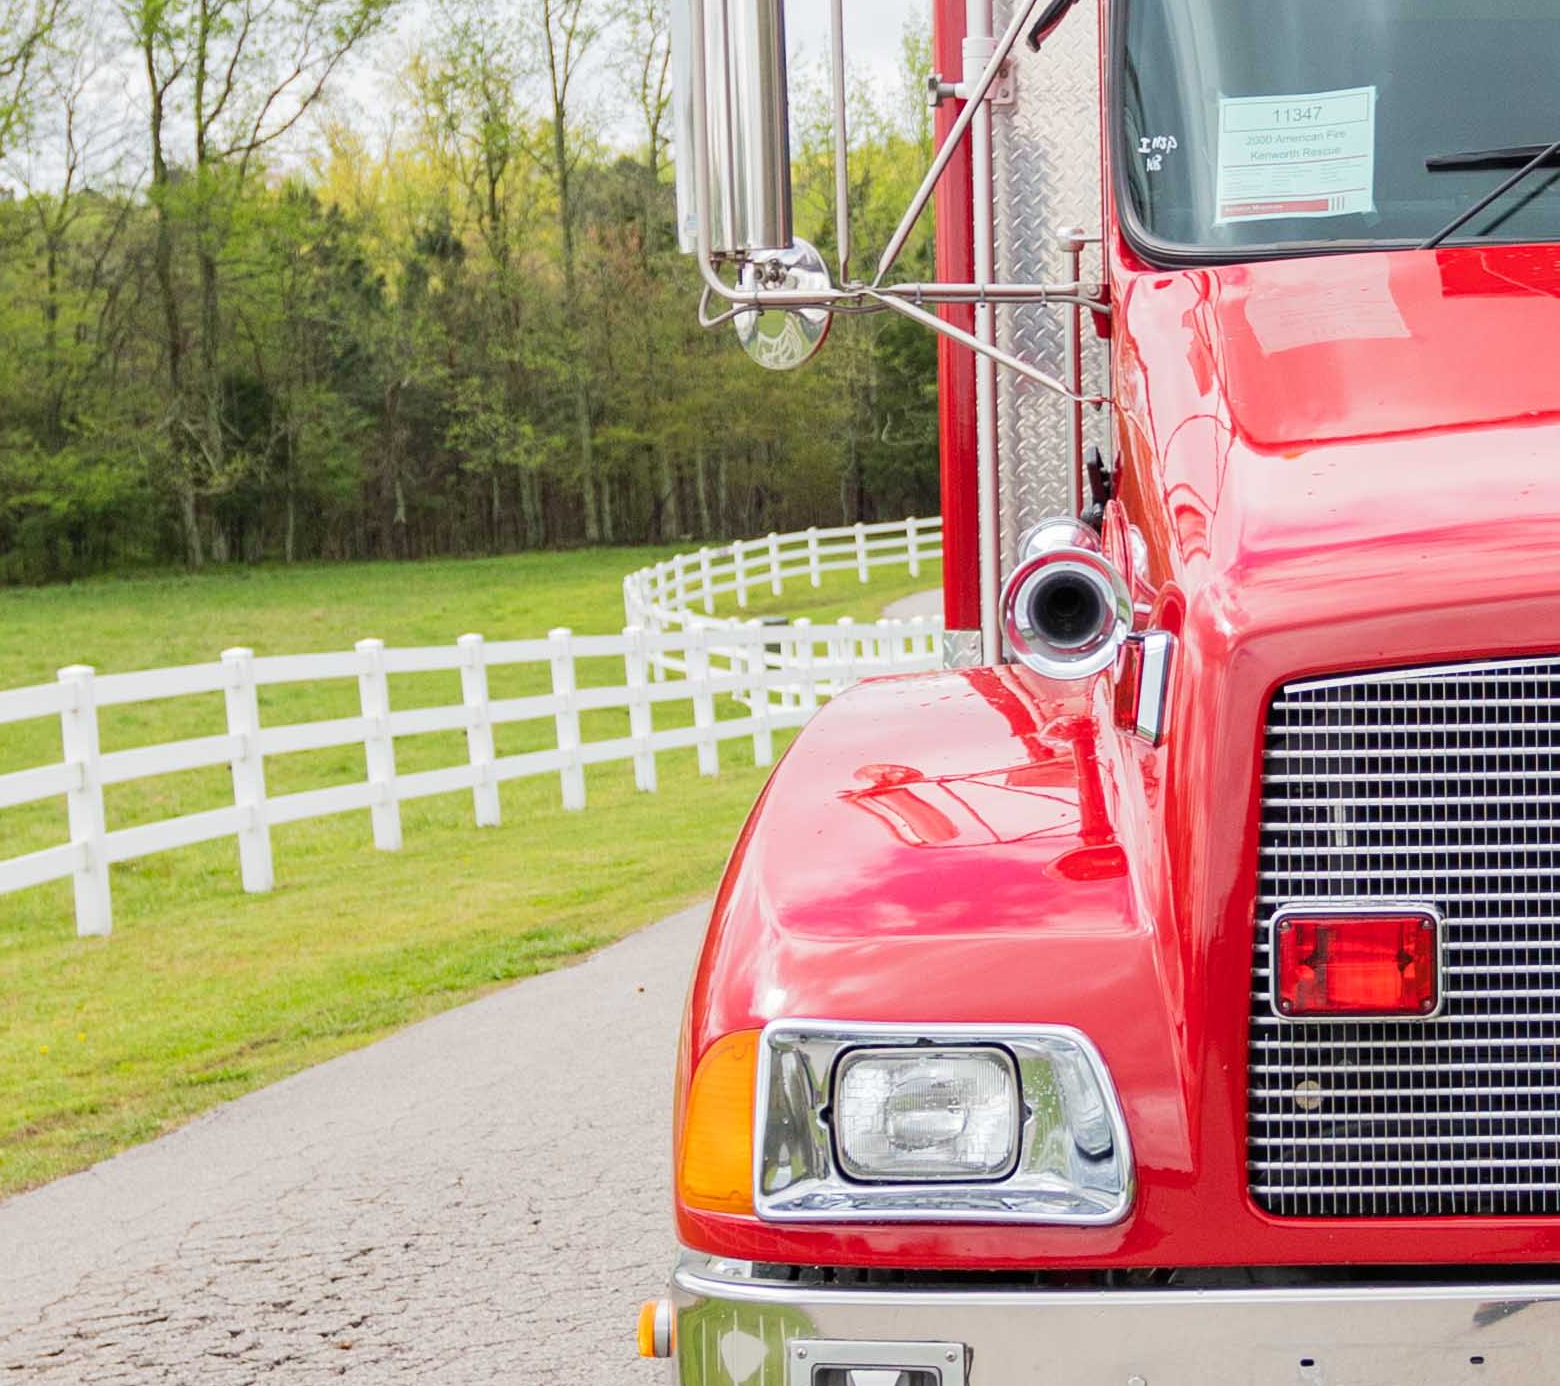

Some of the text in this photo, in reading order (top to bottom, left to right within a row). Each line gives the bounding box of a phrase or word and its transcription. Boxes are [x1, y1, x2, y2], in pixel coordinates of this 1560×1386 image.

[1272, 106, 1322, 123] 11347
[1275, 131, 1324, 144] American
[1326, 129, 1347, 140] Fire
[1250, 146, 1341, 161] Kenworth Rescue
